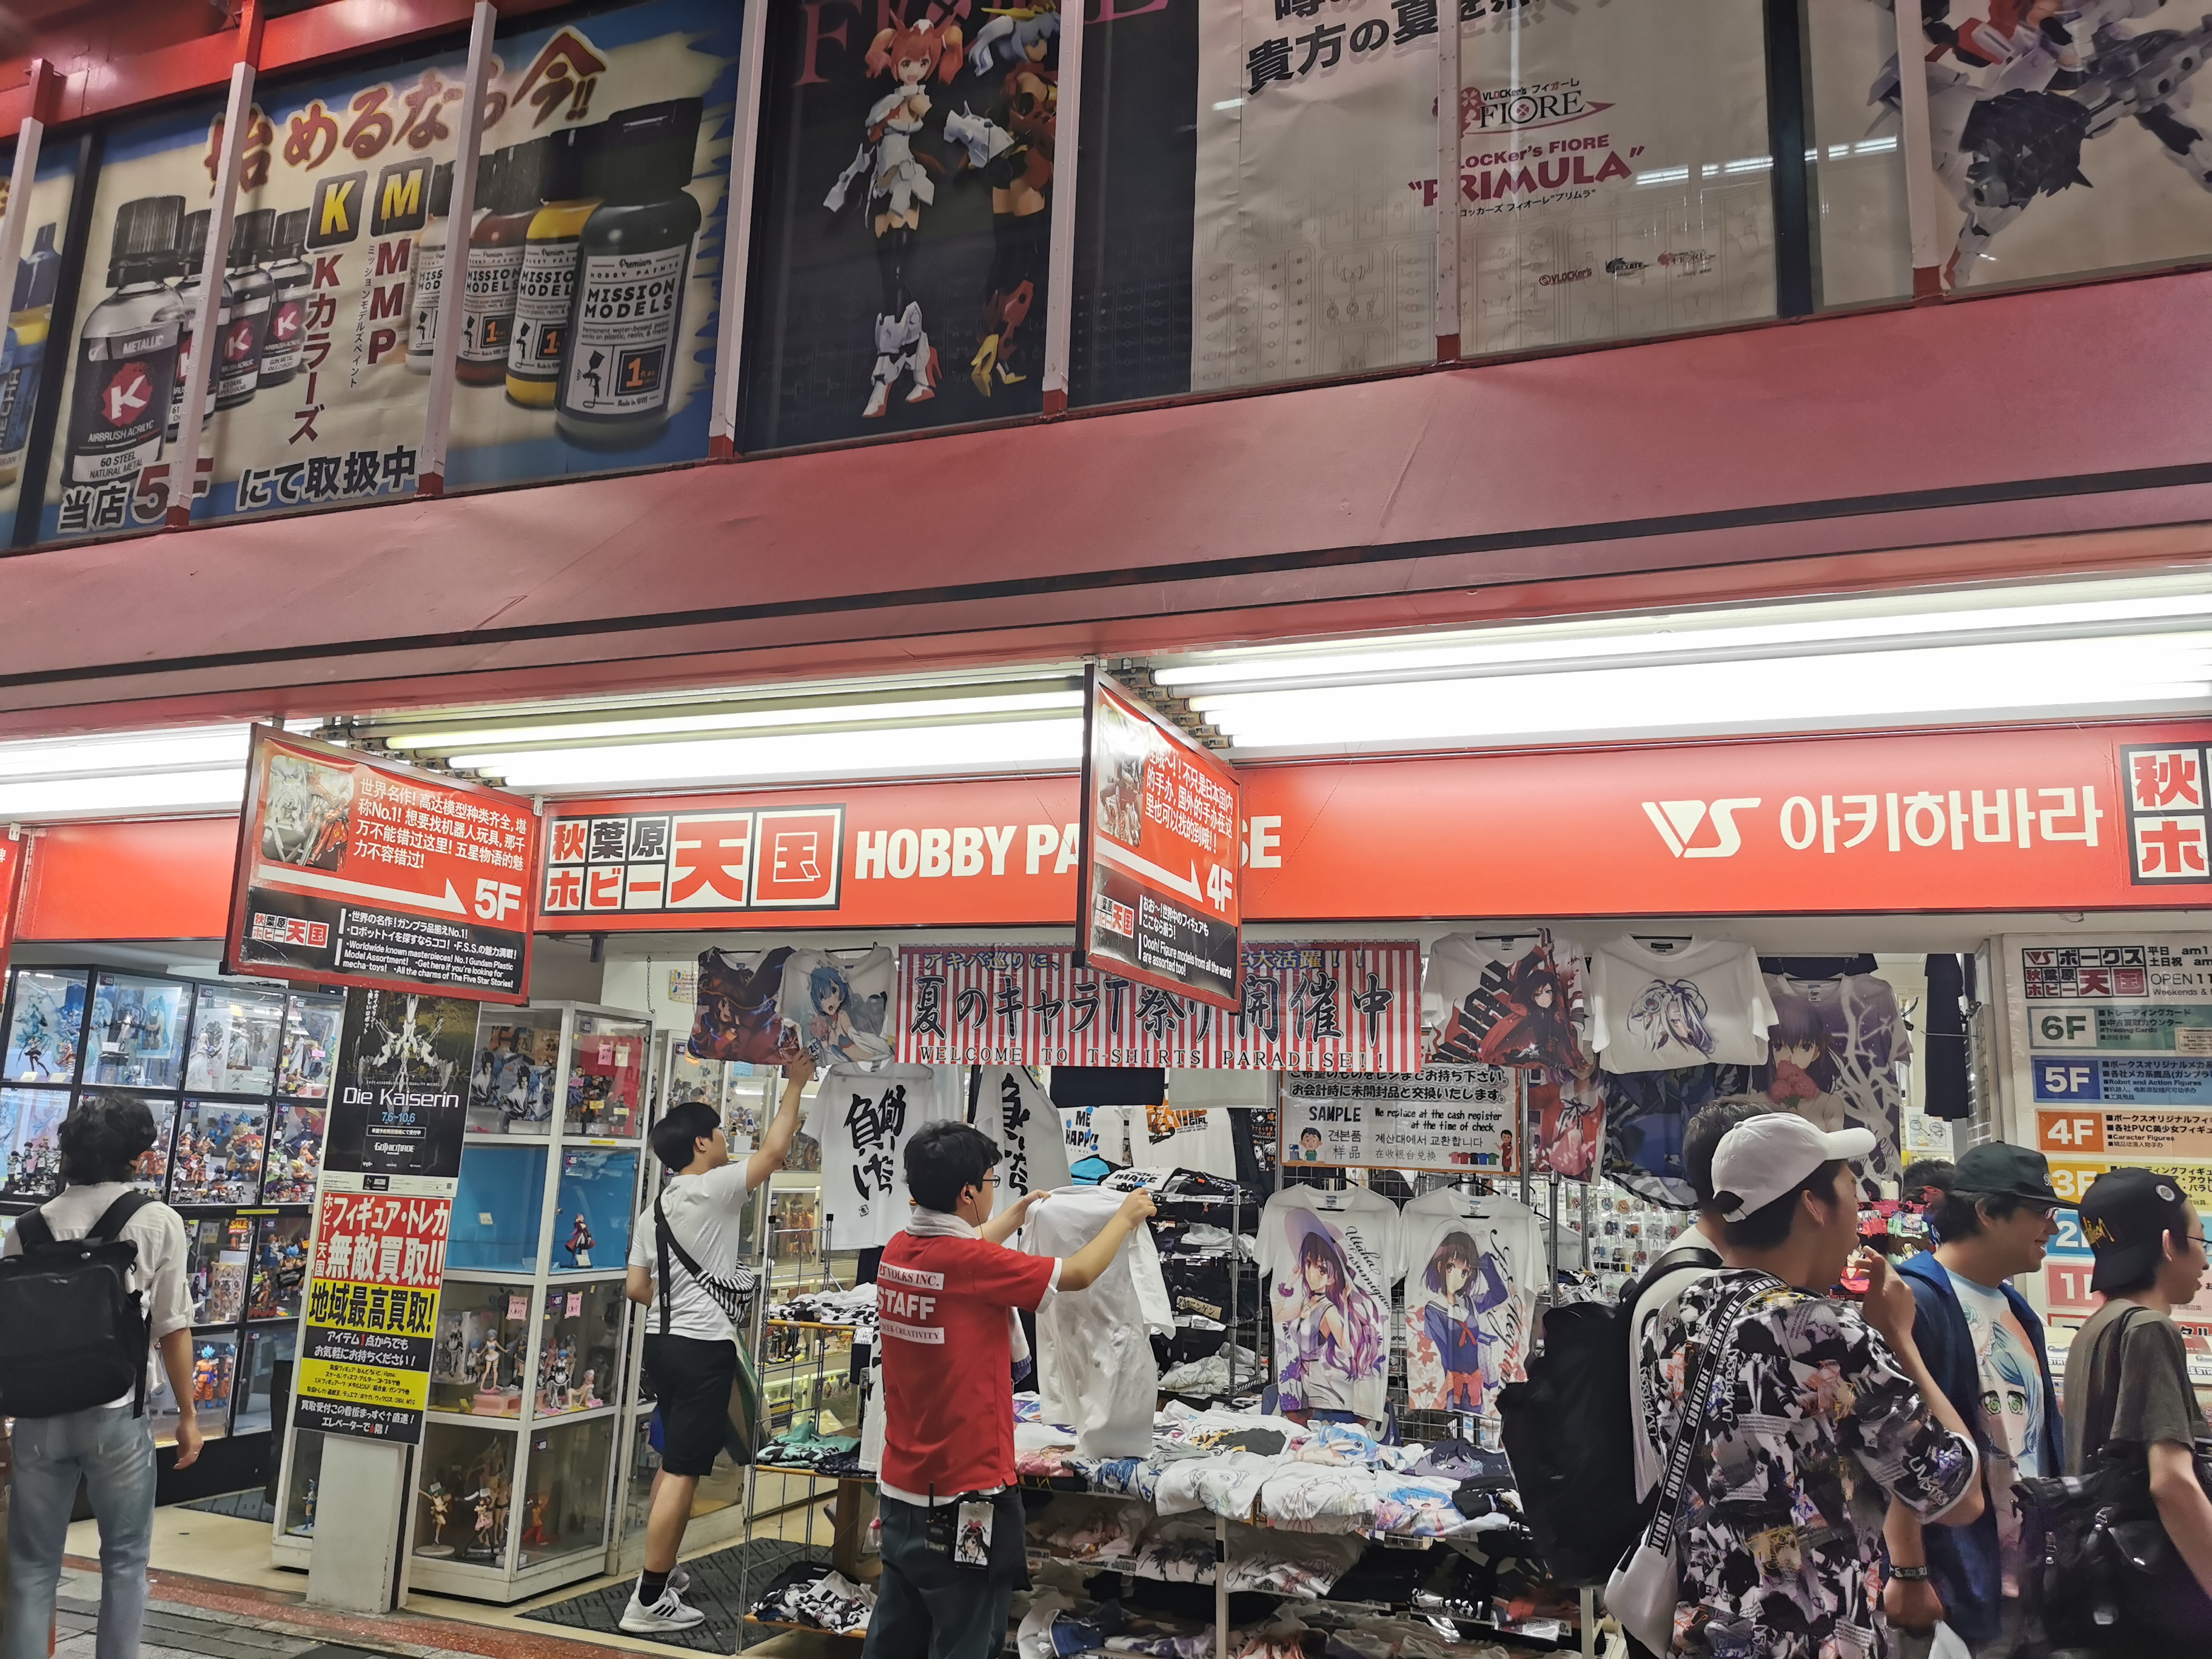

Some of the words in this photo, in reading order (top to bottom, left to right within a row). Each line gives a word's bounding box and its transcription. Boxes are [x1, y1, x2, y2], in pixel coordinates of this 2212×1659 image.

[1478, 91, 1586, 129] FIORE
[1549, 135, 1610, 155] FIORE
[320, 188, 353, 235] K
[381, 169, 421, 221] M
[521, 270, 574, 283] MISSIO
[587, 278, 675, 303] MISSION
[584, 295, 672, 318] MODELS
[123, 335, 164, 355] METALLIC
[288, 253, 344, 446] Kカラーズ
[88, 427, 127, 443] AIRBRUSH
[90, 465, 121, 478] NATURAL
[123, 459, 142, 472] METAL
[100, 457, 112, 467] 60
[113, 451, 136, 464] STEEL
[244, 445, 417, 503] にて取扱中
[1779, 786, 2103, 853] 아키하바라
[552, 822, 665, 860] 秋葉原
[856, 825, 1017, 879] HOBBY
[670, 815, 835, 903] 天国
[474, 878, 521, 921] 5F
[548, 868, 661, 908] ホビー
[1207, 863, 1233, 911] 4F
[344, 950, 366, 960] Model
[366, 954, 408, 966] Assortment!
[472, 968, 493, 977] looking
[349, 940, 384, 953] Worldwide
[386, 946, 407, 956] known
[408, 950, 453, 963] masterpieces!
[469, 959, 492, 968] Gundam
[493, 961, 514, 971] Plastic
[1143, 936, 1160, 950] Oooh!
[1161, 943, 1177, 959] Figure
[1178, 950, 1195, 964] models
[1195, 956, 1205, 970] from
[1219, 966, 1232, 979] world
[1143, 953, 1152, 964] are
[1153, 954, 1175, 973] assorted
[1176, 962, 1186, 976] too!
[2059, 950, 2143, 965] ボークス
[2148, 947, 2169, 956] 平日
[2150, 957, 2183, 967] 土日祝
[343, 960, 387, 972] mecha-toys!
[405, 967, 417, 975] the
[418, 970, 441, 979] charms
[450, 973, 462, 982] The
[491, 978, 513, 988] Stories!
[2151, 973, 2193, 985] OPEN
[2041, 1015, 2086, 1041] 6F
[920, 1046, 1023, 1062] WELCOME
[1041, 1048, 1067, 1062] TO
[1088, 1048, 1201, 1065] T-SHIRTS
[2045, 1067, 2091, 1092] 5F
[343, 1087, 373, 1105] Die
[380, 1088, 459, 1108] Kaiserin
[1189, 1118, 1208, 1126] GIRL
[1309, 1105, 1361, 1122] SAMPLE
[1375, 1107, 1385, 1118] We
[1387, 1108, 1416, 1120] replace
[1419, 1110, 1429, 1118] at
[1430, 1109, 1445, 1119] the
[1447, 1110, 1465, 1119] cash
[1468, 1111, 1503, 1122] register
[1328, 1130, 1361, 1143] 견본품
[1375, 1134, 1427, 1145] 계산대에서
[1430, 1136, 1484, 1148] 교환합니다
[1411, 1121, 1421, 1130] at
[1423, 1121, 1437, 1130] the
[1439, 1121, 1457, 1131] time
[1459, 1122, 1470, 1131] of
[1472, 1122, 1495, 1133] check
[2048, 1119, 2094, 1145] 4F
[1332, 1144, 1361, 1160] 样品
[332, 1196, 449, 1236] フィギュア・トレカ
[315, 1193, 333, 1276] ホビー天国
[326, 1230, 444, 1287] 無敵買取!!
[886, 1267, 914, 1283] VOLKS
[915, 1273, 940, 1287] INC.
[309, 1282, 435, 1333] 地域最高買取!
[877, 1286, 936, 1320] STAFF
[895, 1326, 939, 1340] CREATIVITY
[1709, 1299, 1741, 1356] CONVERSE
[1686, 1367, 1711, 1428] CONVERSE
[1665, 1438, 1691, 1500] CONVERSE
